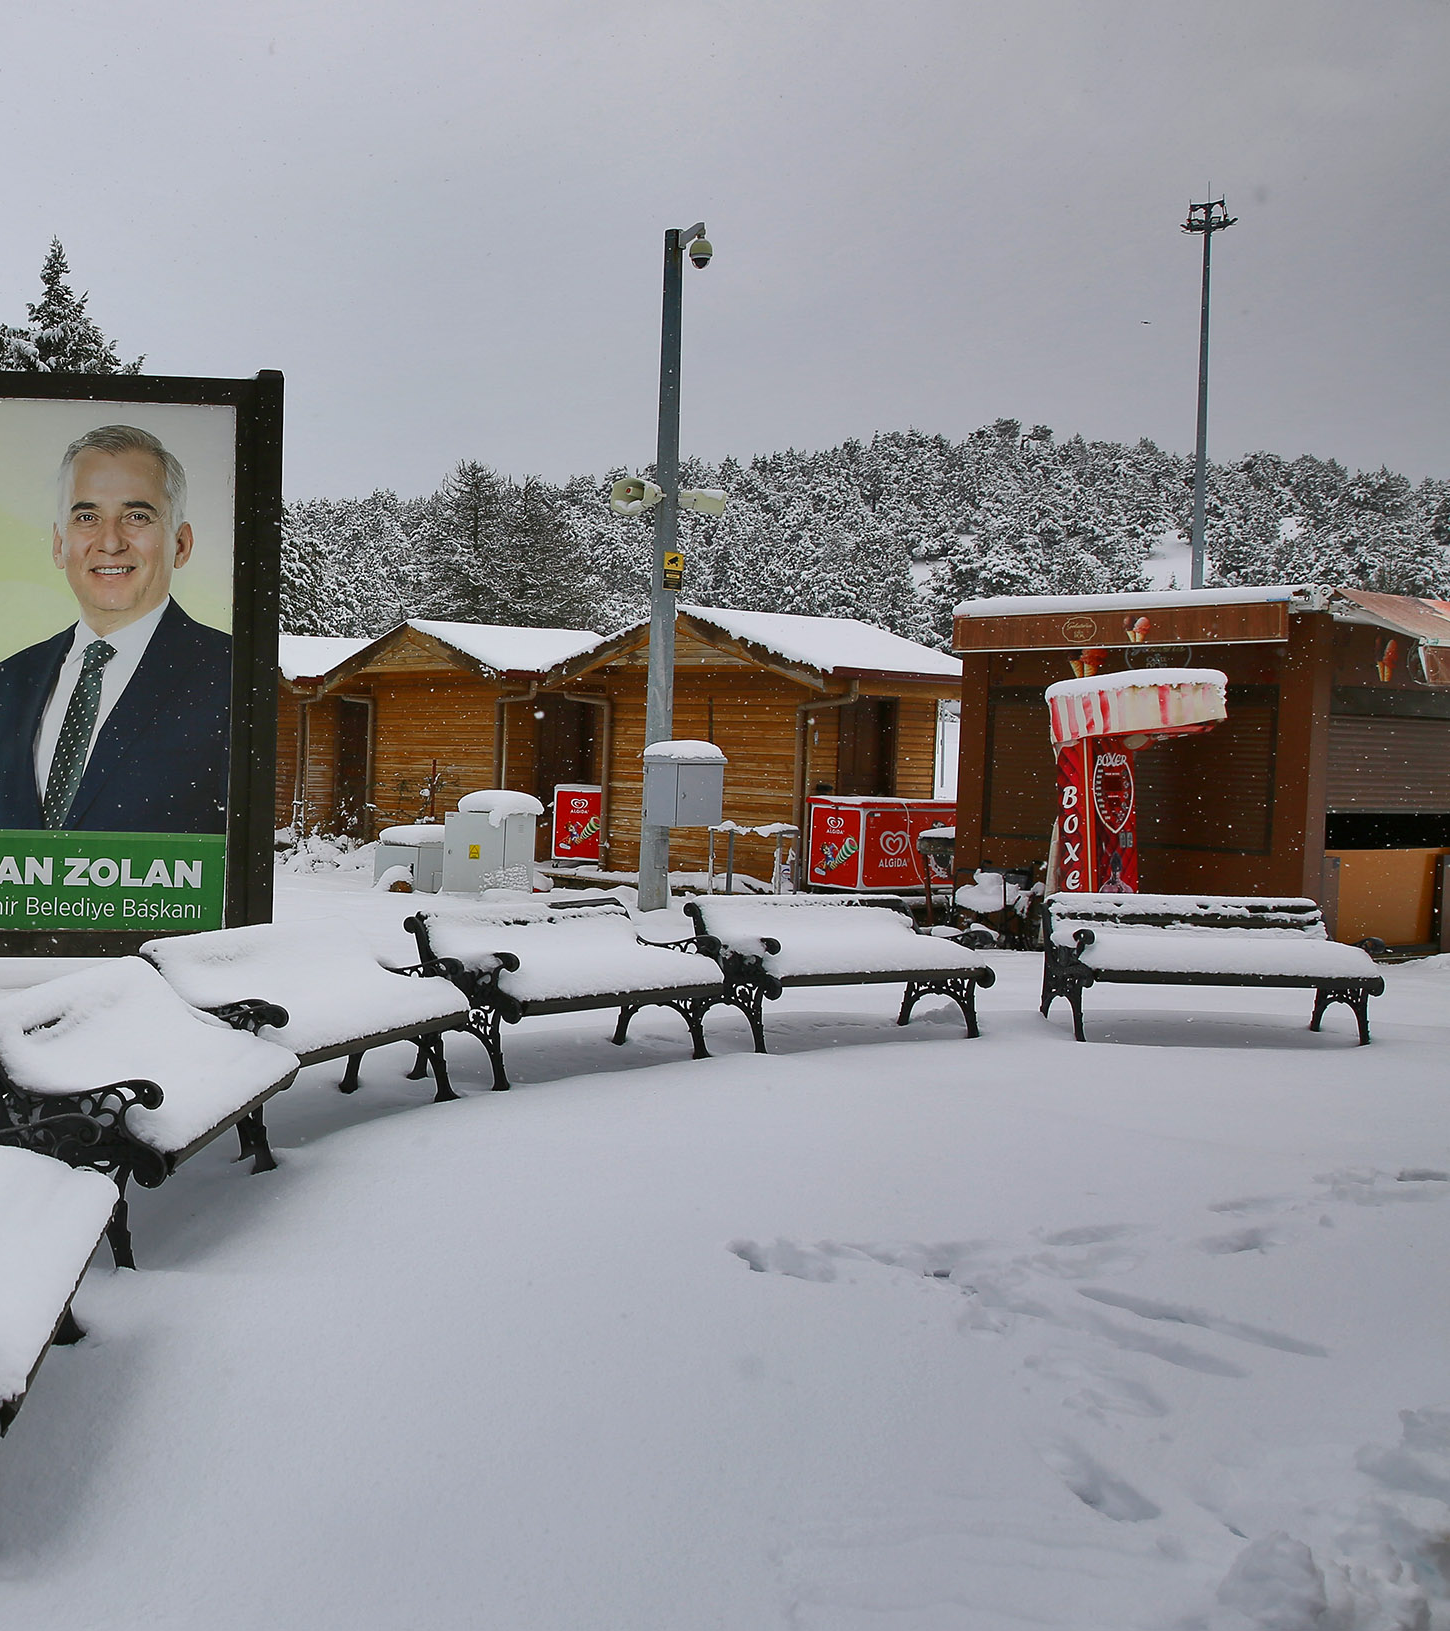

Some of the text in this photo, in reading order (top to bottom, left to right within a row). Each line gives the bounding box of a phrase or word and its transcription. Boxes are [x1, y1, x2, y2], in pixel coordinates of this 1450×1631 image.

[1097, 753, 1127, 767] BOXER
[62, 857, 202, 889] ZOLAN
[25, 897, 115, 920] Belediye
[122, 898, 202, 921] Başkanı
